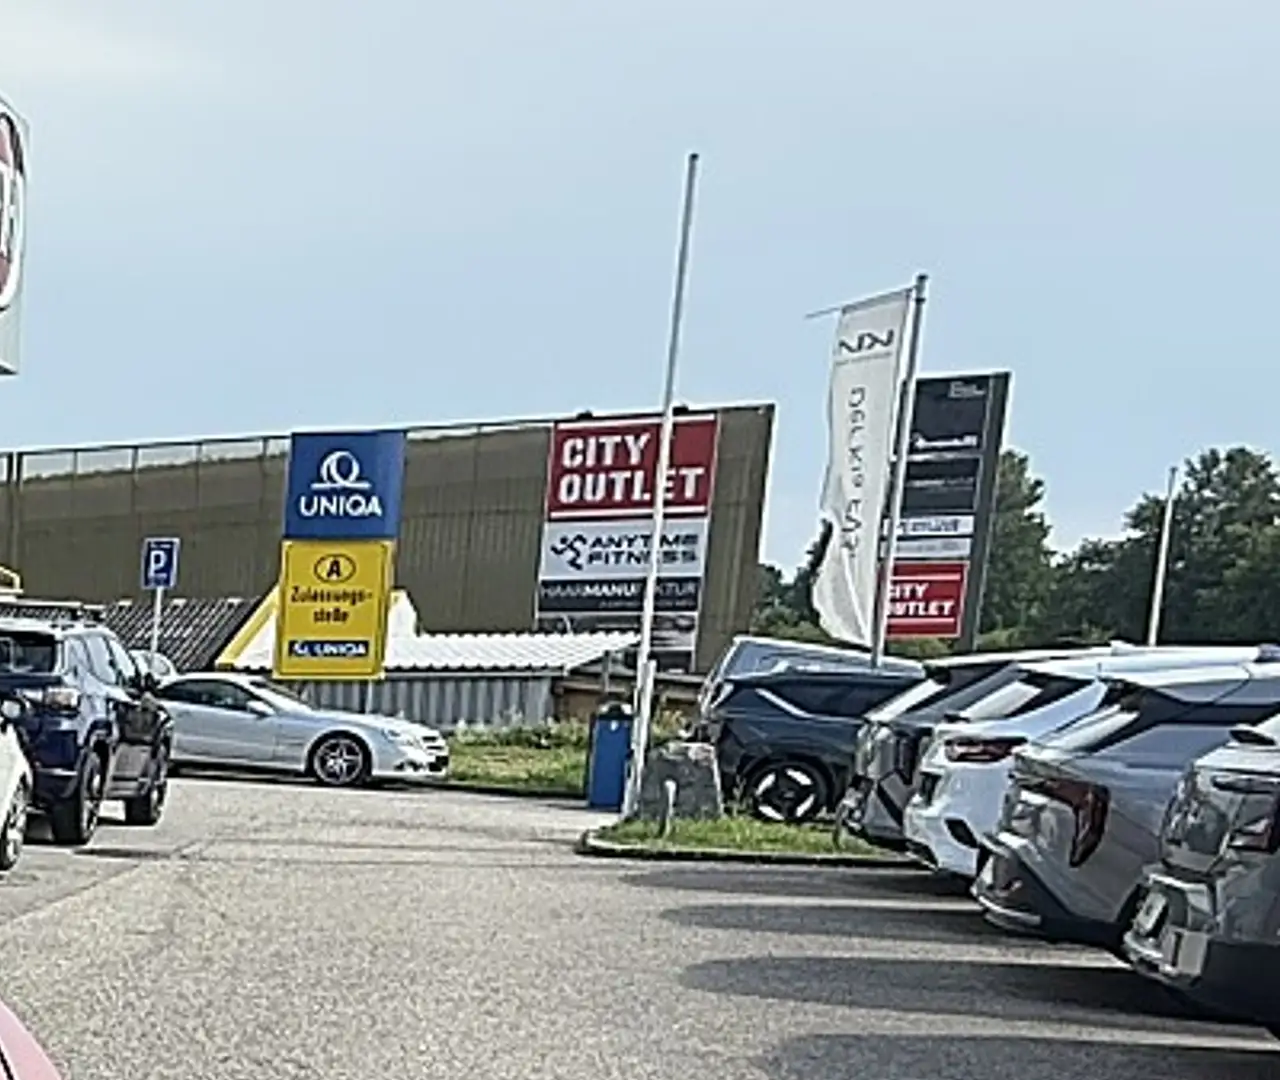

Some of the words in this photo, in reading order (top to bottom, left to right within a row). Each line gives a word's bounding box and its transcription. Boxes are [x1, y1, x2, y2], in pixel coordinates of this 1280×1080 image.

[561, 432, 651, 469] CITY
[557, 467, 705, 504] OUTLET
[299, 495, 382, 517] UNIQA
[589, 533, 699, 549] ANYTME
[148, 549, 168, 577] P
[327, 559, 343, 578] A
[587, 550, 697, 566] FITNSS
